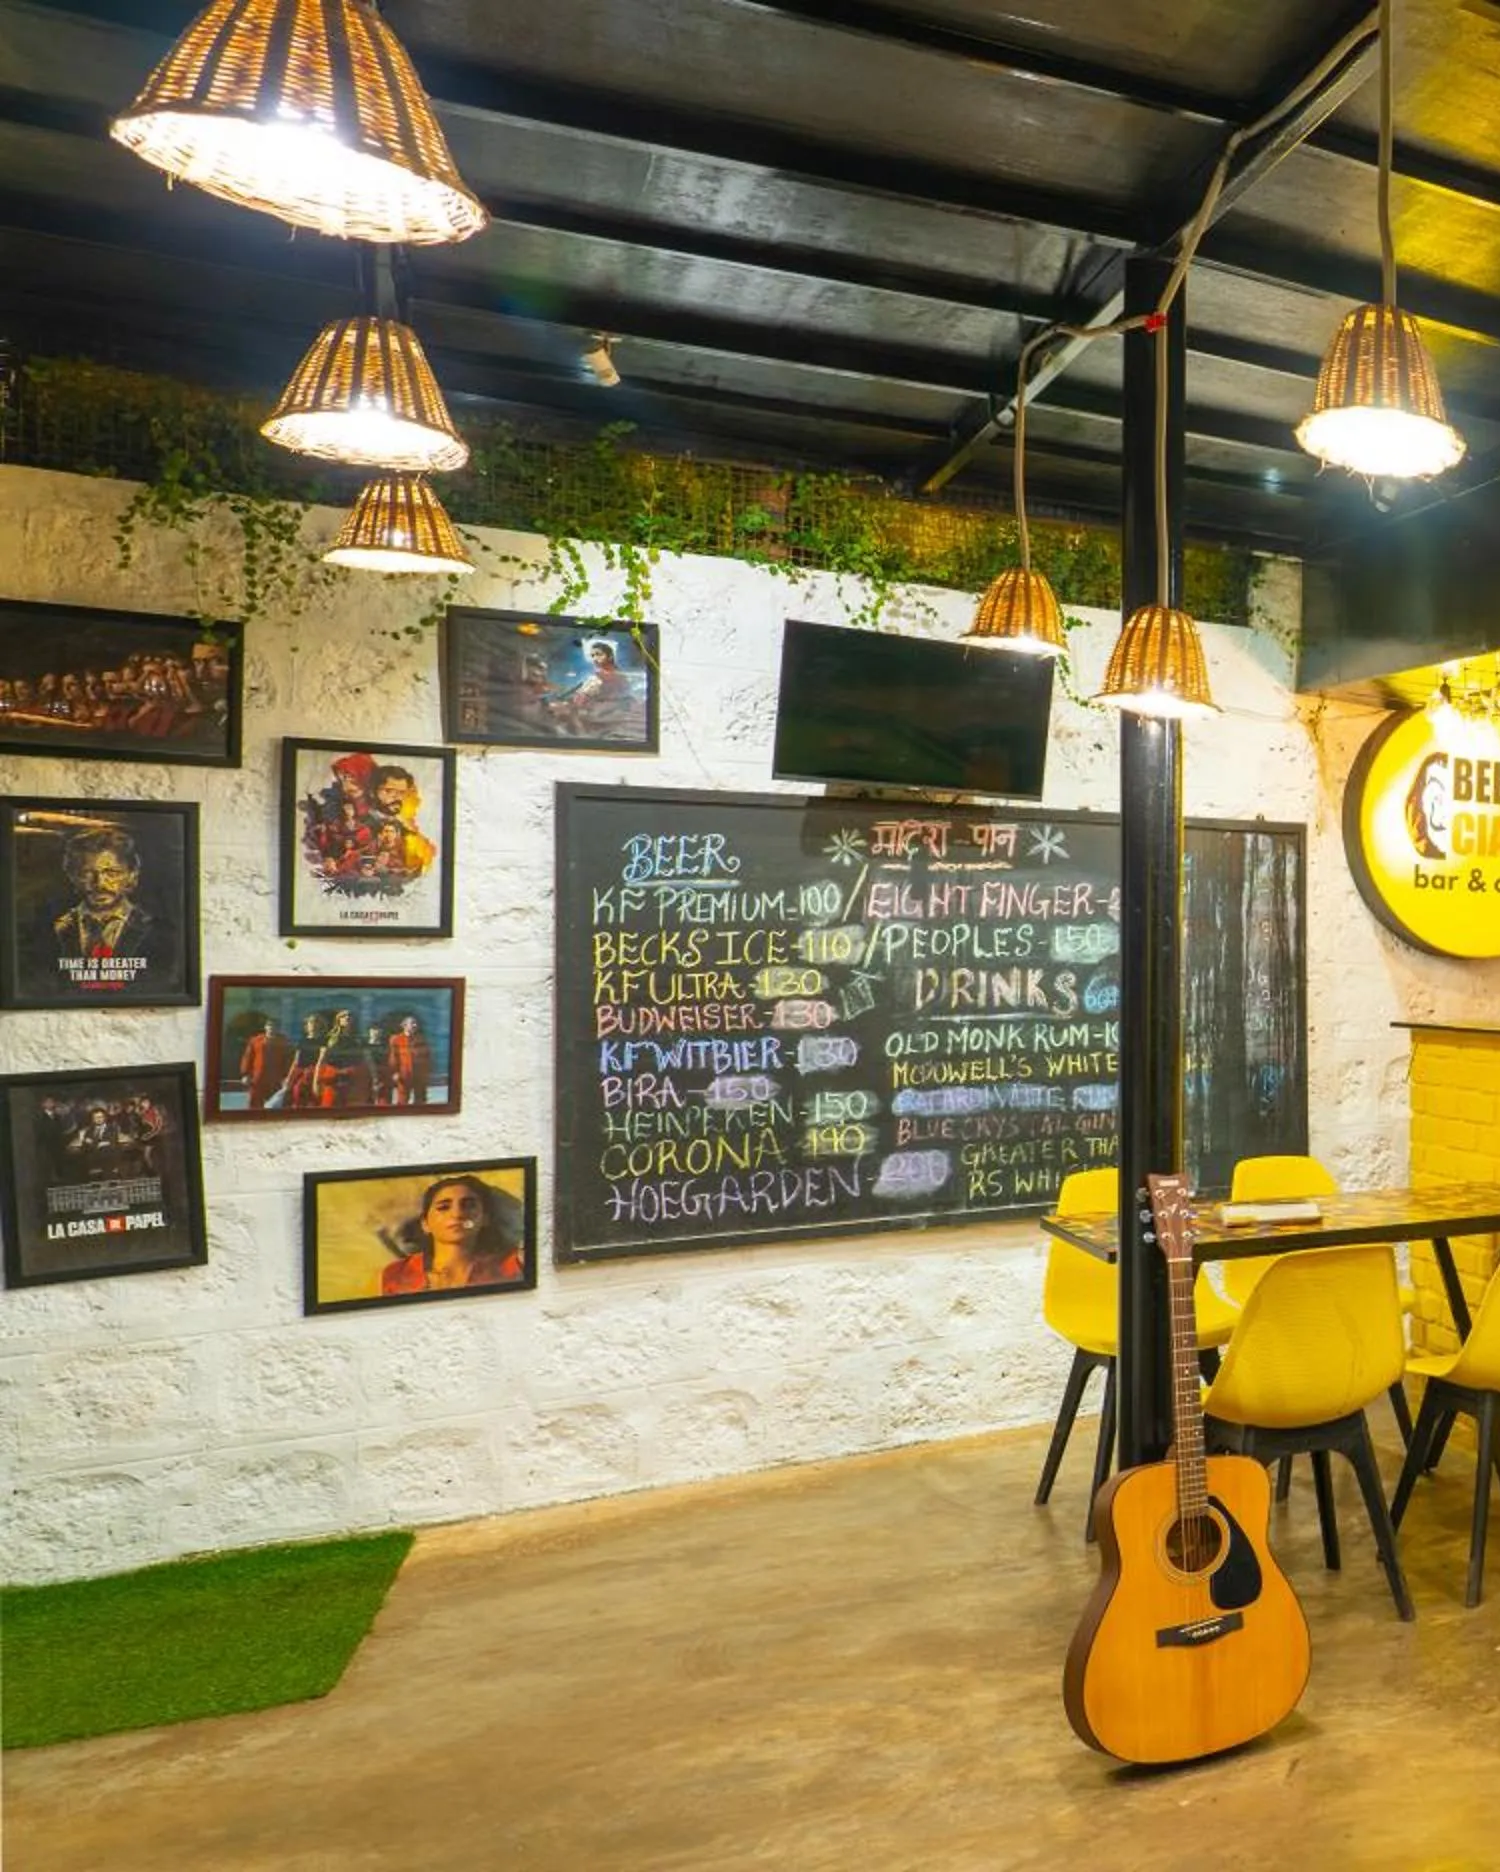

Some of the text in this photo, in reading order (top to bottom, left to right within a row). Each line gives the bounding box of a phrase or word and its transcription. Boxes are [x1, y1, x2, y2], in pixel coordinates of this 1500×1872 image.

[622, 833, 740, 881] BEER
[1413, 864, 1458, 890] bar
[1467, 868, 1487, 893] &
[593, 887, 645, 925] KF
[868, 883, 973, 918] EIGHT
[59, 957, 147, 969] TIME IS GREATER
[593, 928, 710, 968] BECKS
[71, 969, 136, 980] THAN MONEY
[593, 970, 647, 1005] KF
[915, 967, 1078, 1016] DRINKS
[600, 1039, 655, 1074] KF
[885, 1030, 939, 1057] OLD
[947, 1022, 1025, 1055] MONK
[1044, 1052, 1119, 1078] WHITE
[601, 1127, 786, 1180] CORONA
[604, 1153, 861, 1222] HOEGARDEN
[47, 1223, 66, 1239] LA
[67, 1218, 106, 1237] CASA
[125, 1212, 166, 1230] PAPEL
